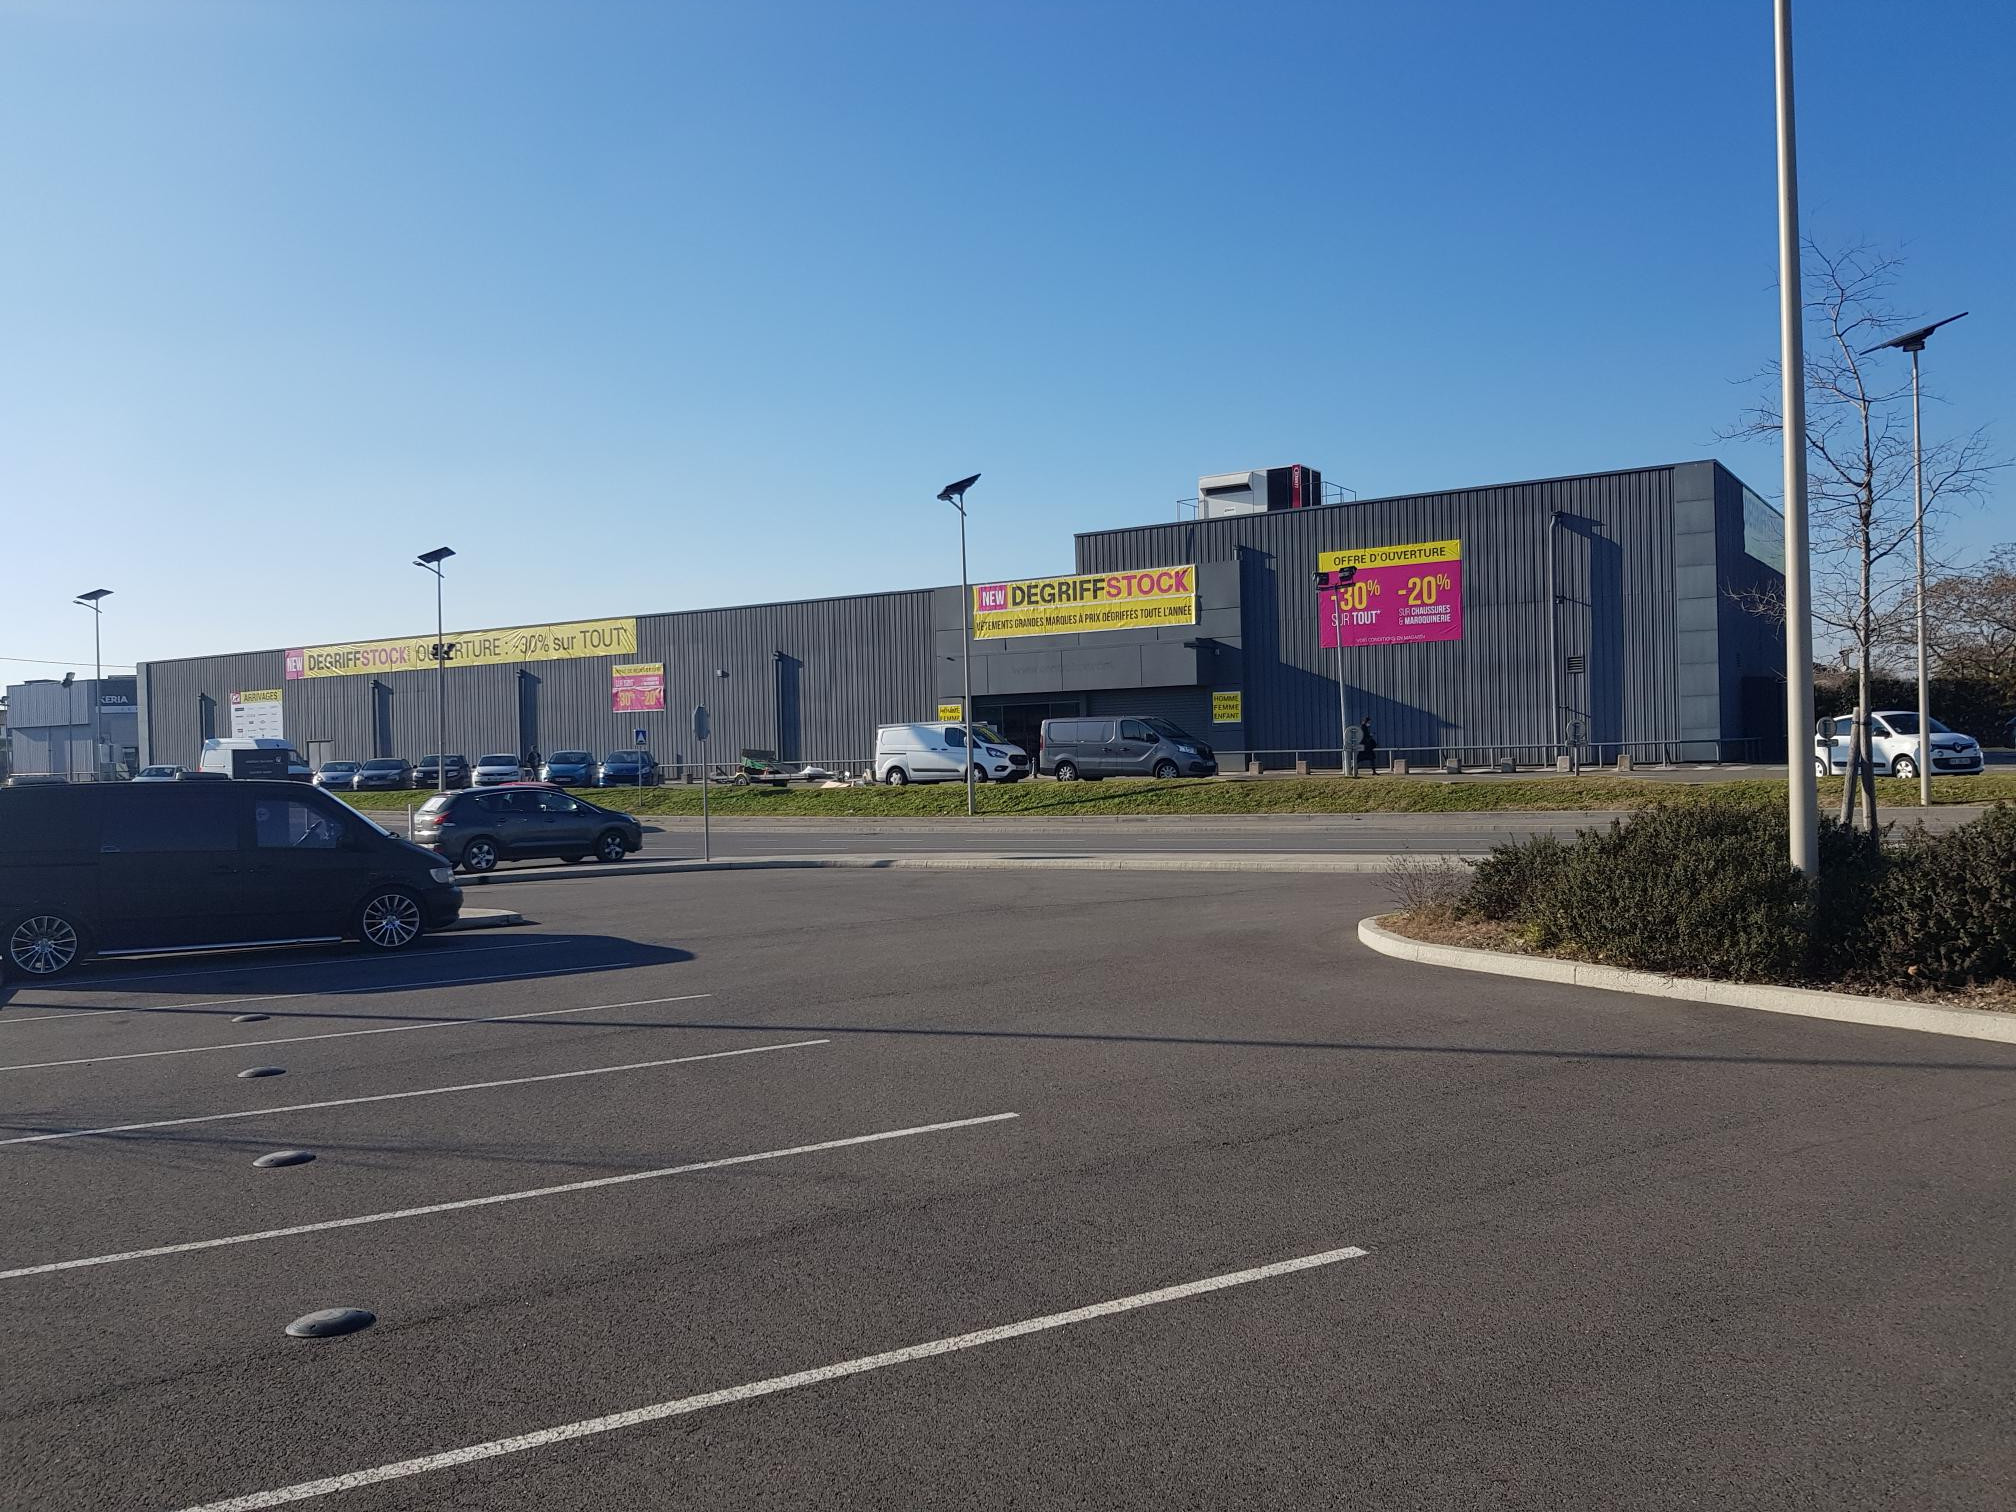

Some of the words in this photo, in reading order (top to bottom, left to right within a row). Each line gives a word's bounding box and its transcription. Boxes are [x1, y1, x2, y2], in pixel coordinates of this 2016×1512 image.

[1333, 554, 1366, 566] OFFRE
[1369, 546, 1446, 562] D'OUVERTURE
[982, 589, 1005, 606] NEW
[1331, 578, 1381, 611] -30%
[1397, 573, 1451, 606] -20%
[1014, 617, 1044, 628] GRANDES
[1045, 614, 1077, 626] MARQUES
[1085, 612, 1101, 623] PRIX
[1102, 607, 1139, 622] DÉGRIFFÉS
[1140, 608, 1162, 618] TOUTE
[1163, 603, 1192, 617] L'ANNÉE
[1398, 607, 1411, 617] SUR
[1411, 605, 1451, 616] CHAUSSURES
[1404, 614, 1451, 625] MAROQUINERIE
[286, 655, 303, 673] NEW
[417, 638, 501, 662] OURTURE
[553, 634, 576, 651] sur
